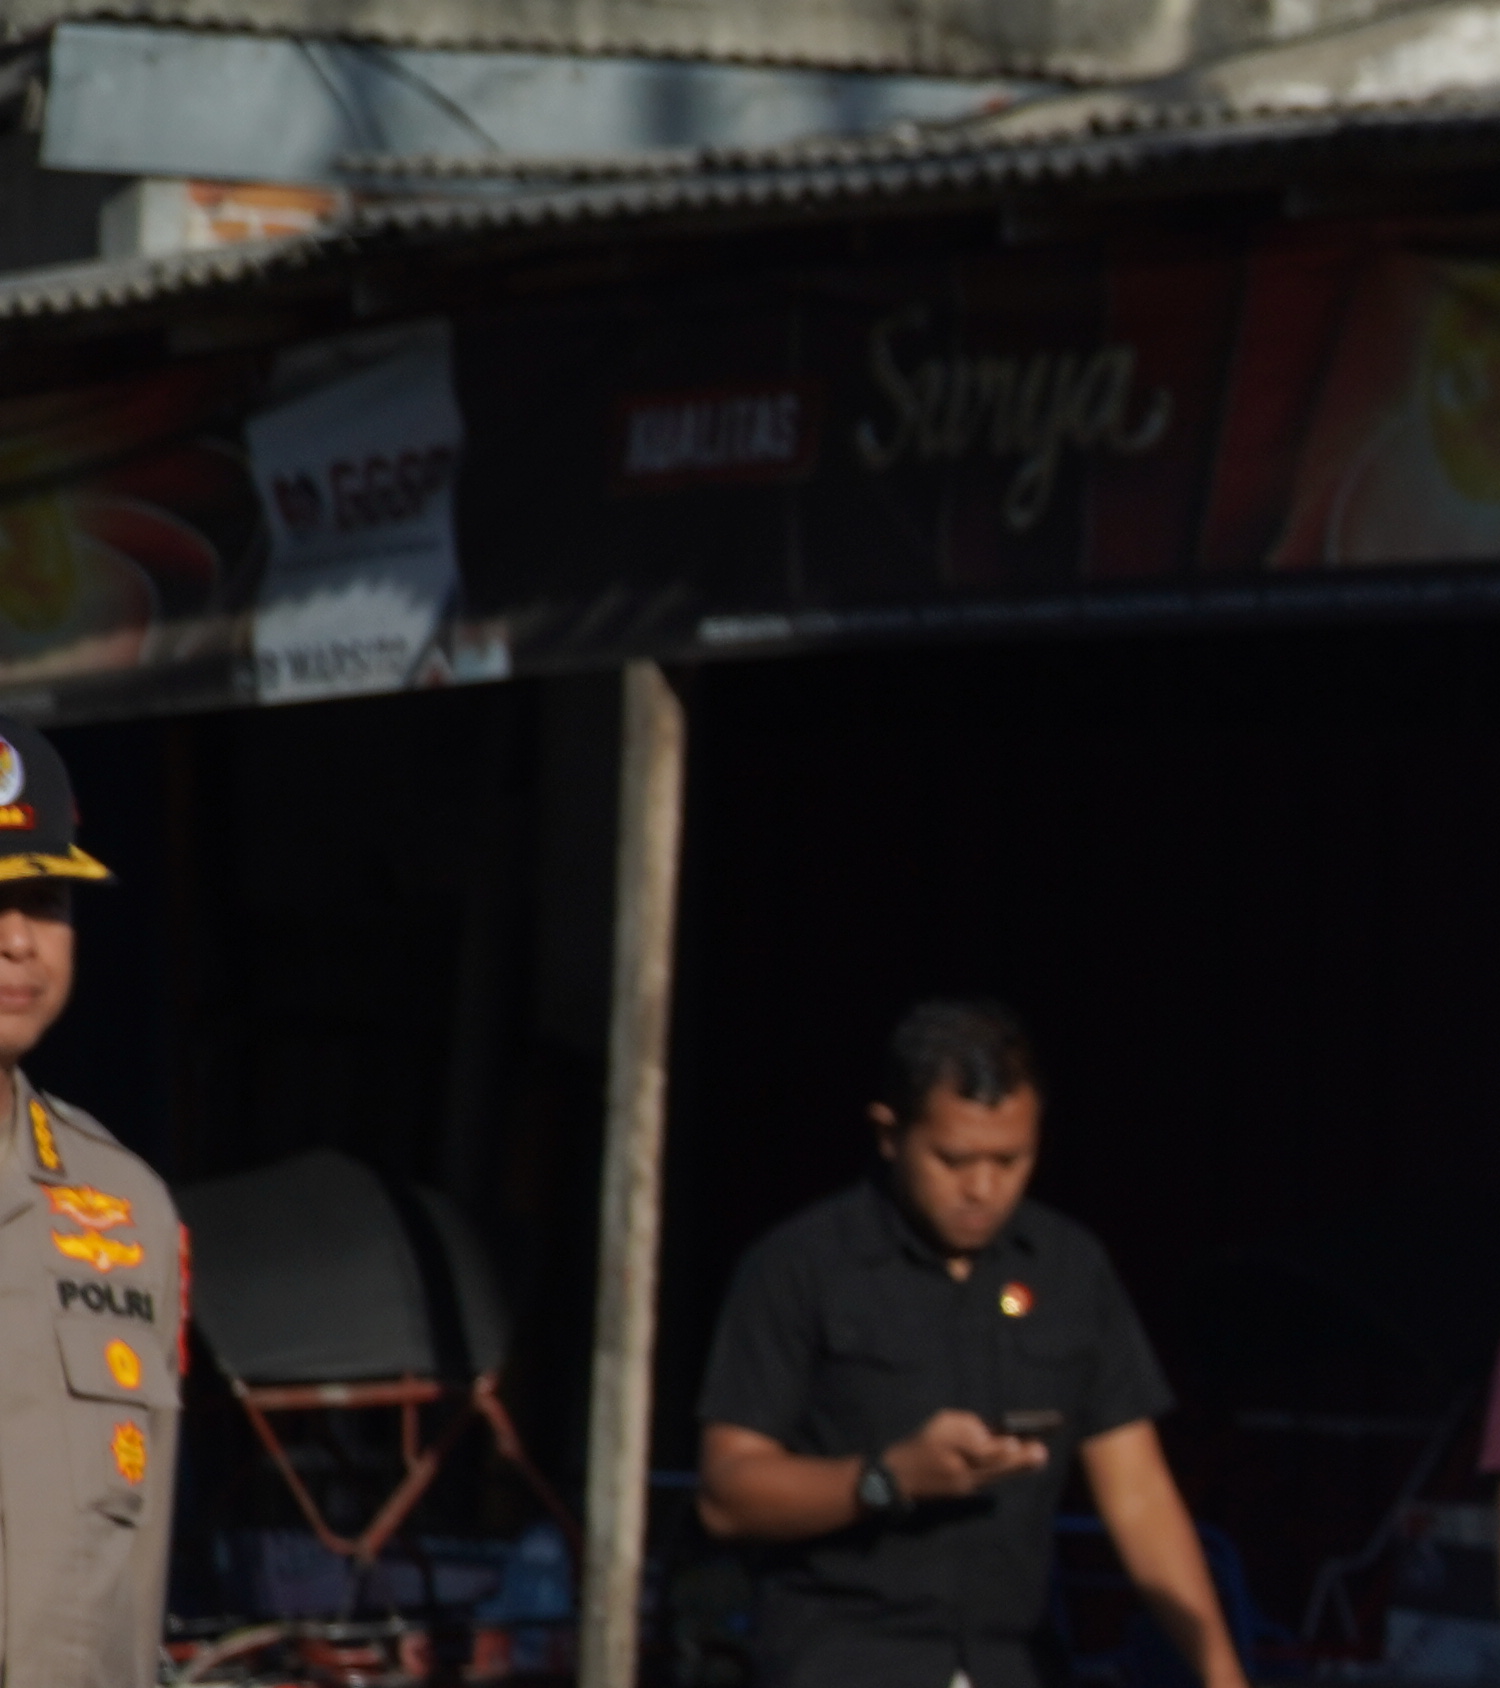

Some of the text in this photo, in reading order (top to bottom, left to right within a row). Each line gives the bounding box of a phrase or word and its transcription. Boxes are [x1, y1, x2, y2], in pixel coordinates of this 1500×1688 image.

[622, 392, 798, 477] KUALITAS
[857, 300, 1174, 533] Surya
[56, 1277, 155, 1324] POLRI
